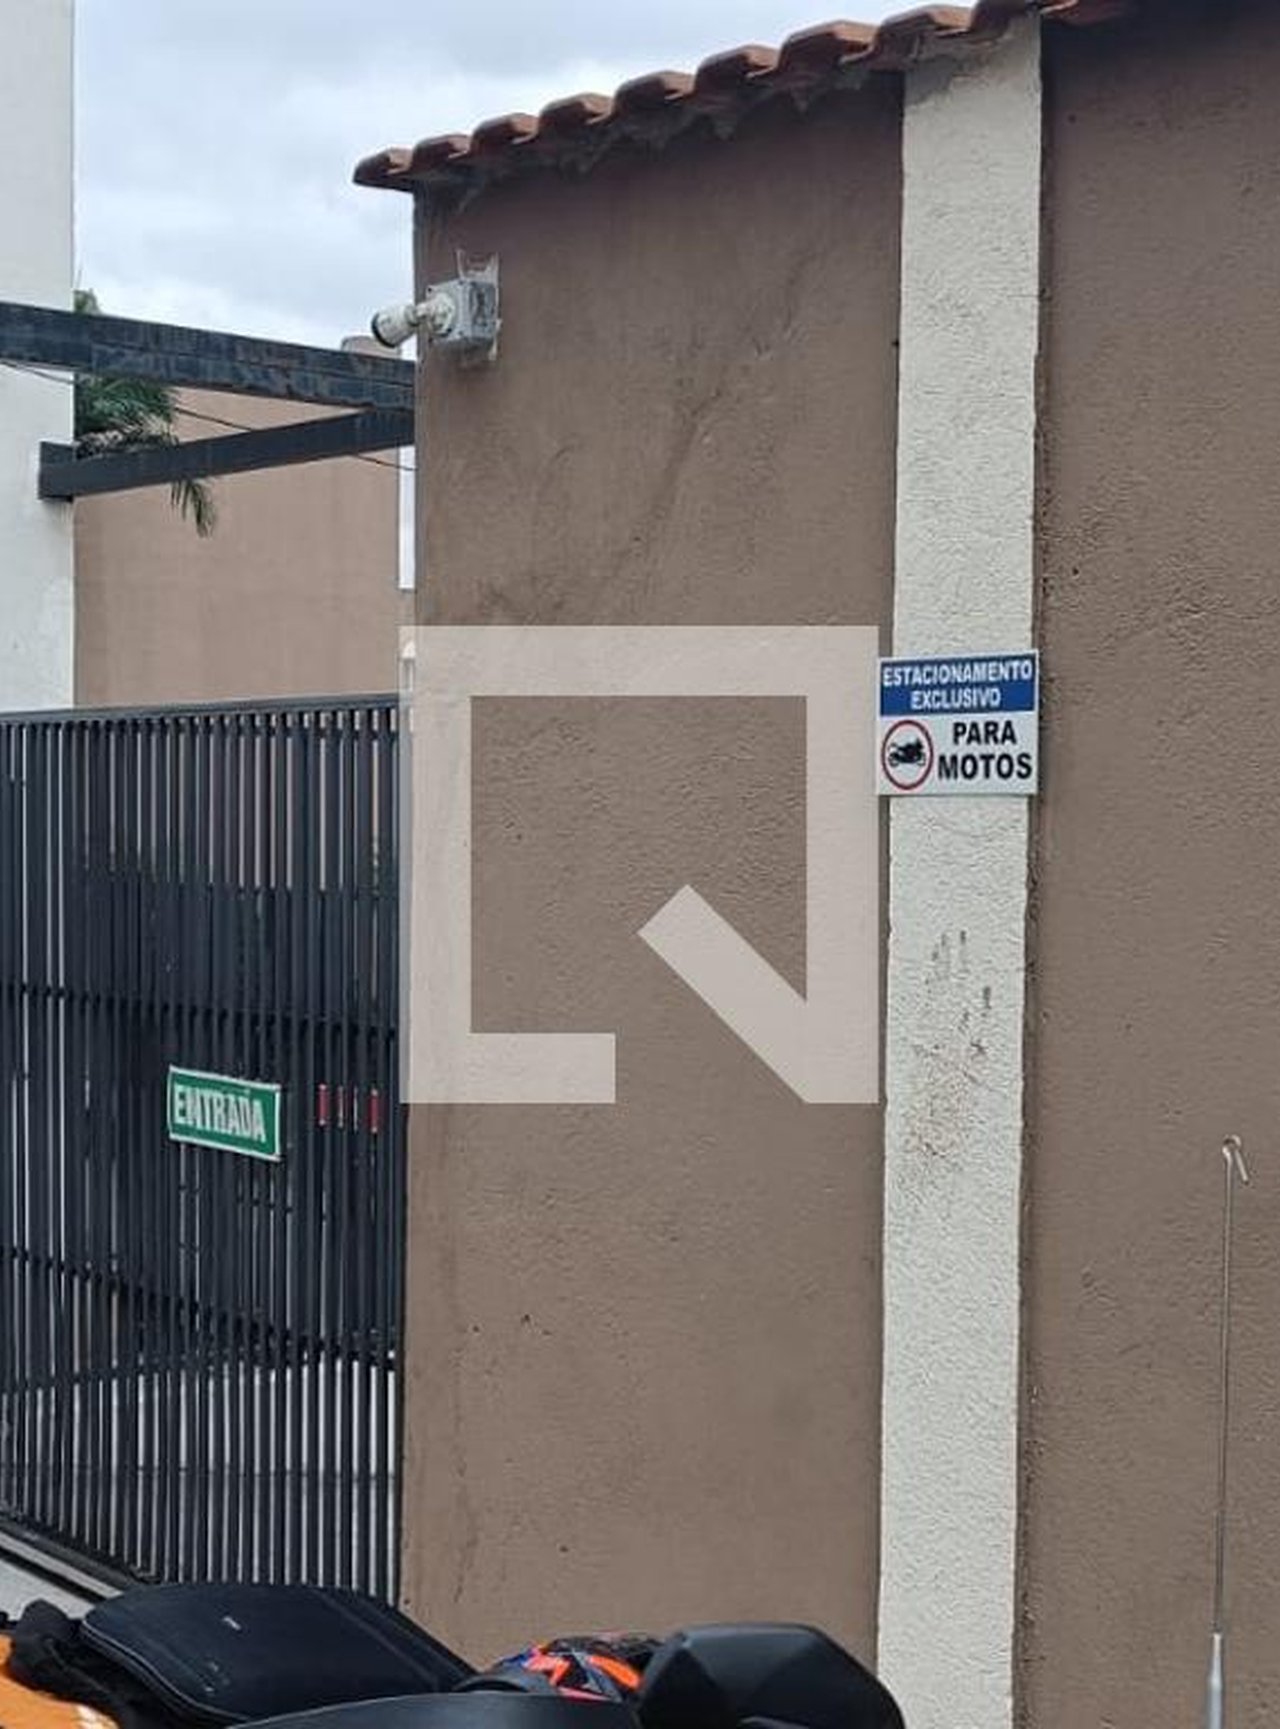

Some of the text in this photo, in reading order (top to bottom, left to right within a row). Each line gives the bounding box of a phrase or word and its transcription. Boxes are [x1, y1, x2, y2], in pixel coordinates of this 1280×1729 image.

[882, 659, 1033, 687] ESTACIONAMENTO
[910, 687, 1002, 710] EXCLUSIVO
[952, 719, 1018, 746] PARA
[937, 752, 1033, 781] MOTOS
[173, 1082, 267, 1143] ENTRADA
